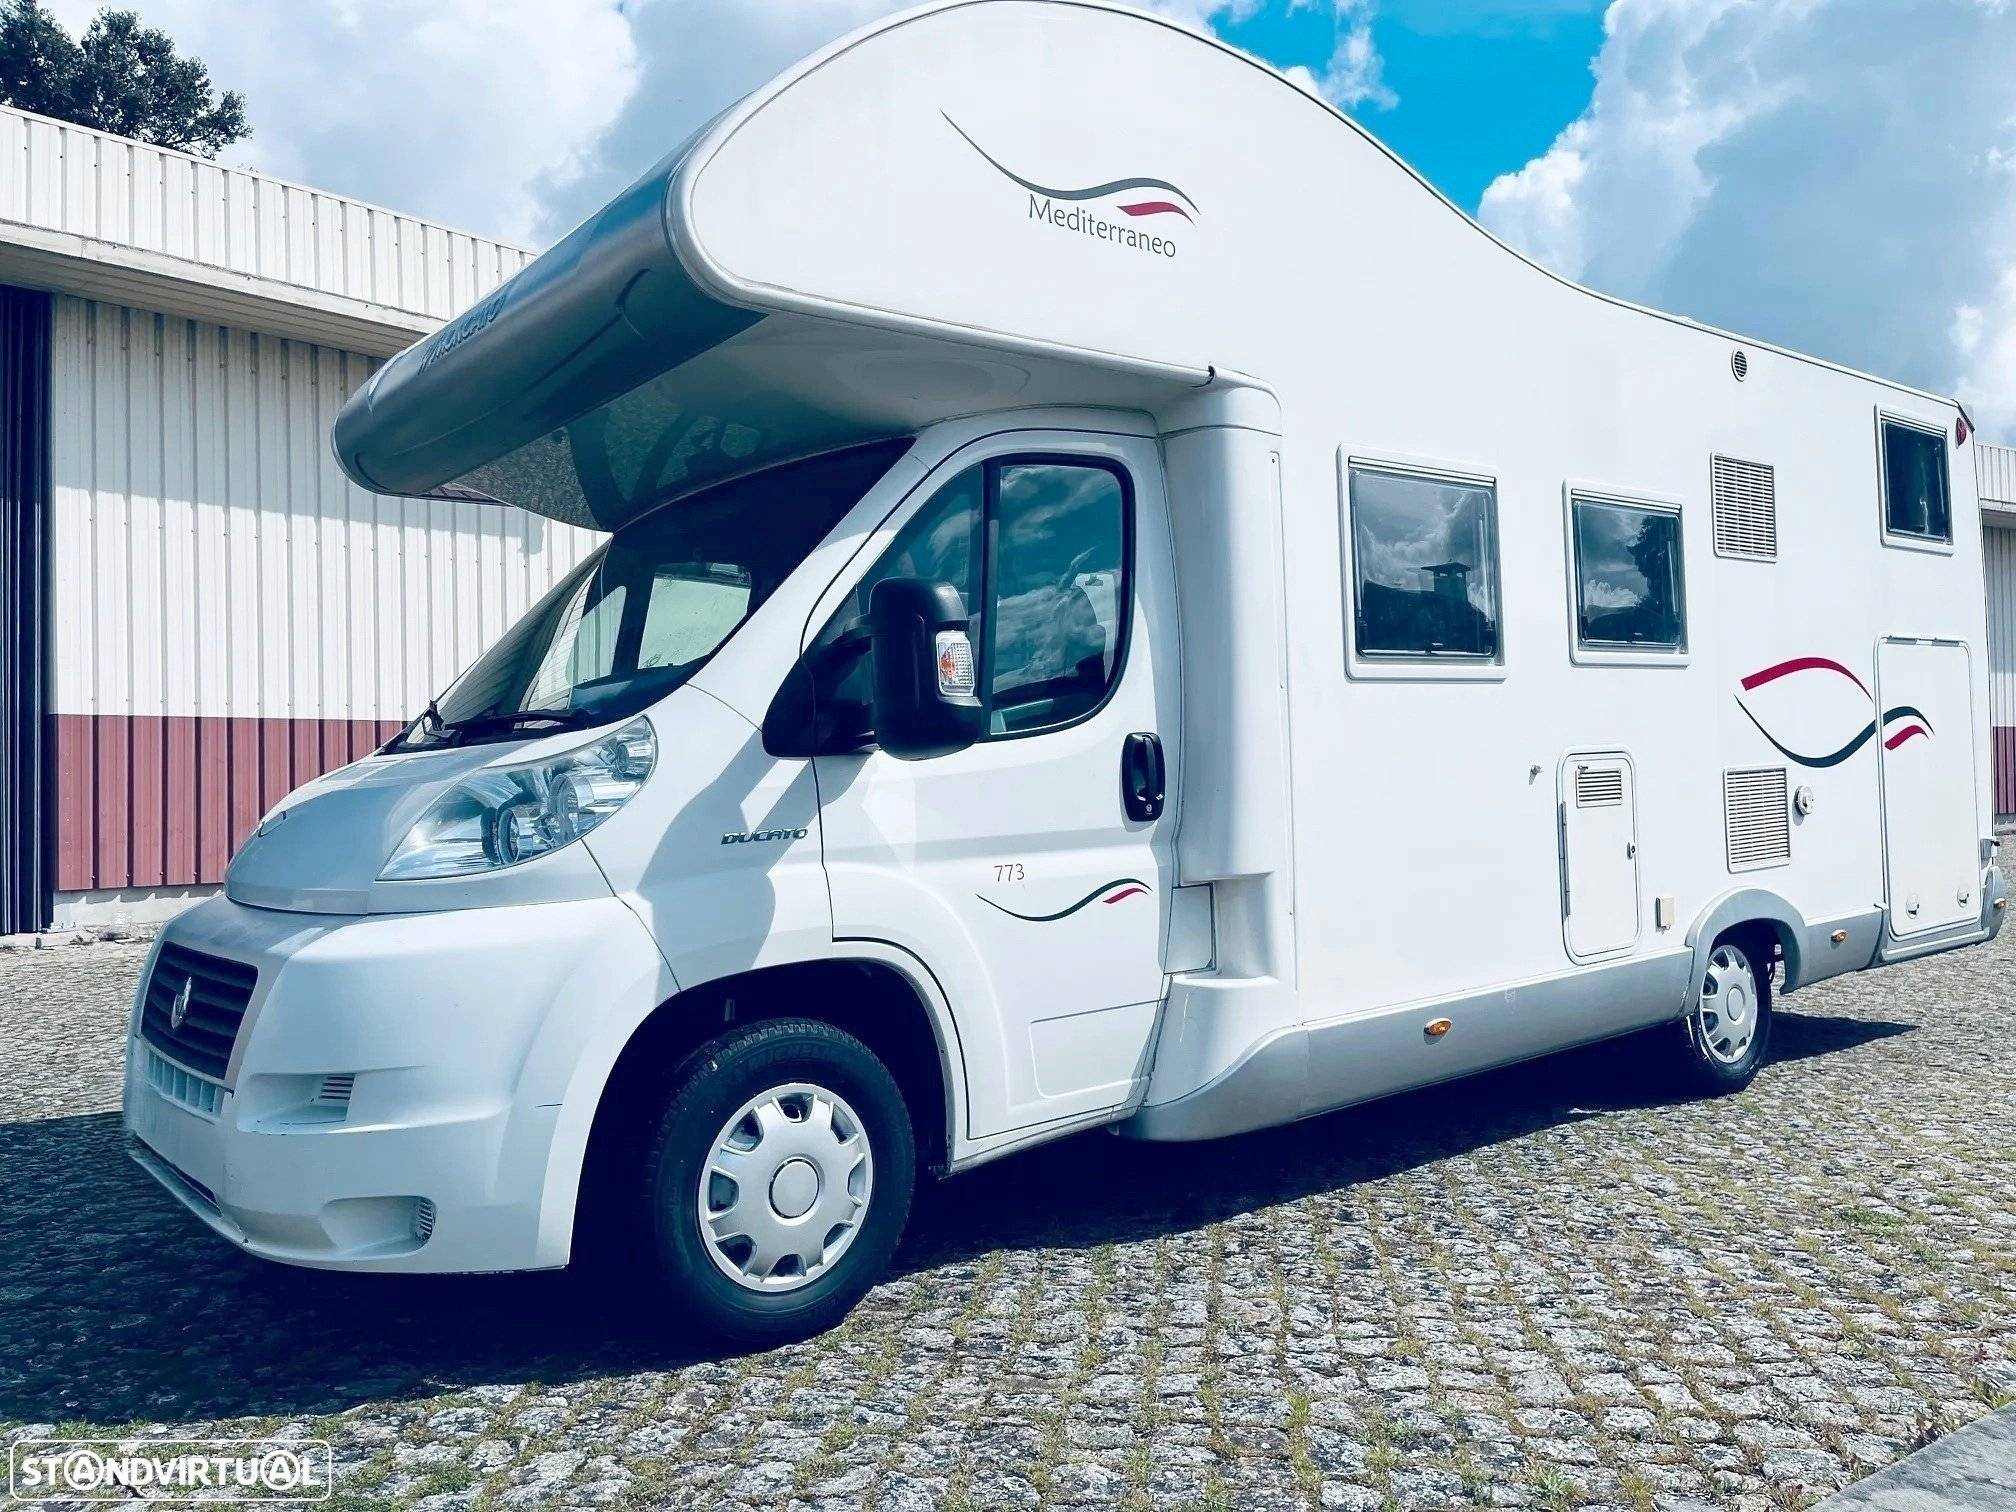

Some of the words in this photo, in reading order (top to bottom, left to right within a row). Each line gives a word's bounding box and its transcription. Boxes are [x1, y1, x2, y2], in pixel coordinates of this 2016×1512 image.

[1029, 193, 1176, 258] Mediterraneo
[720, 828, 809, 845] DUCATO
[993, 863, 1025, 882] 773
